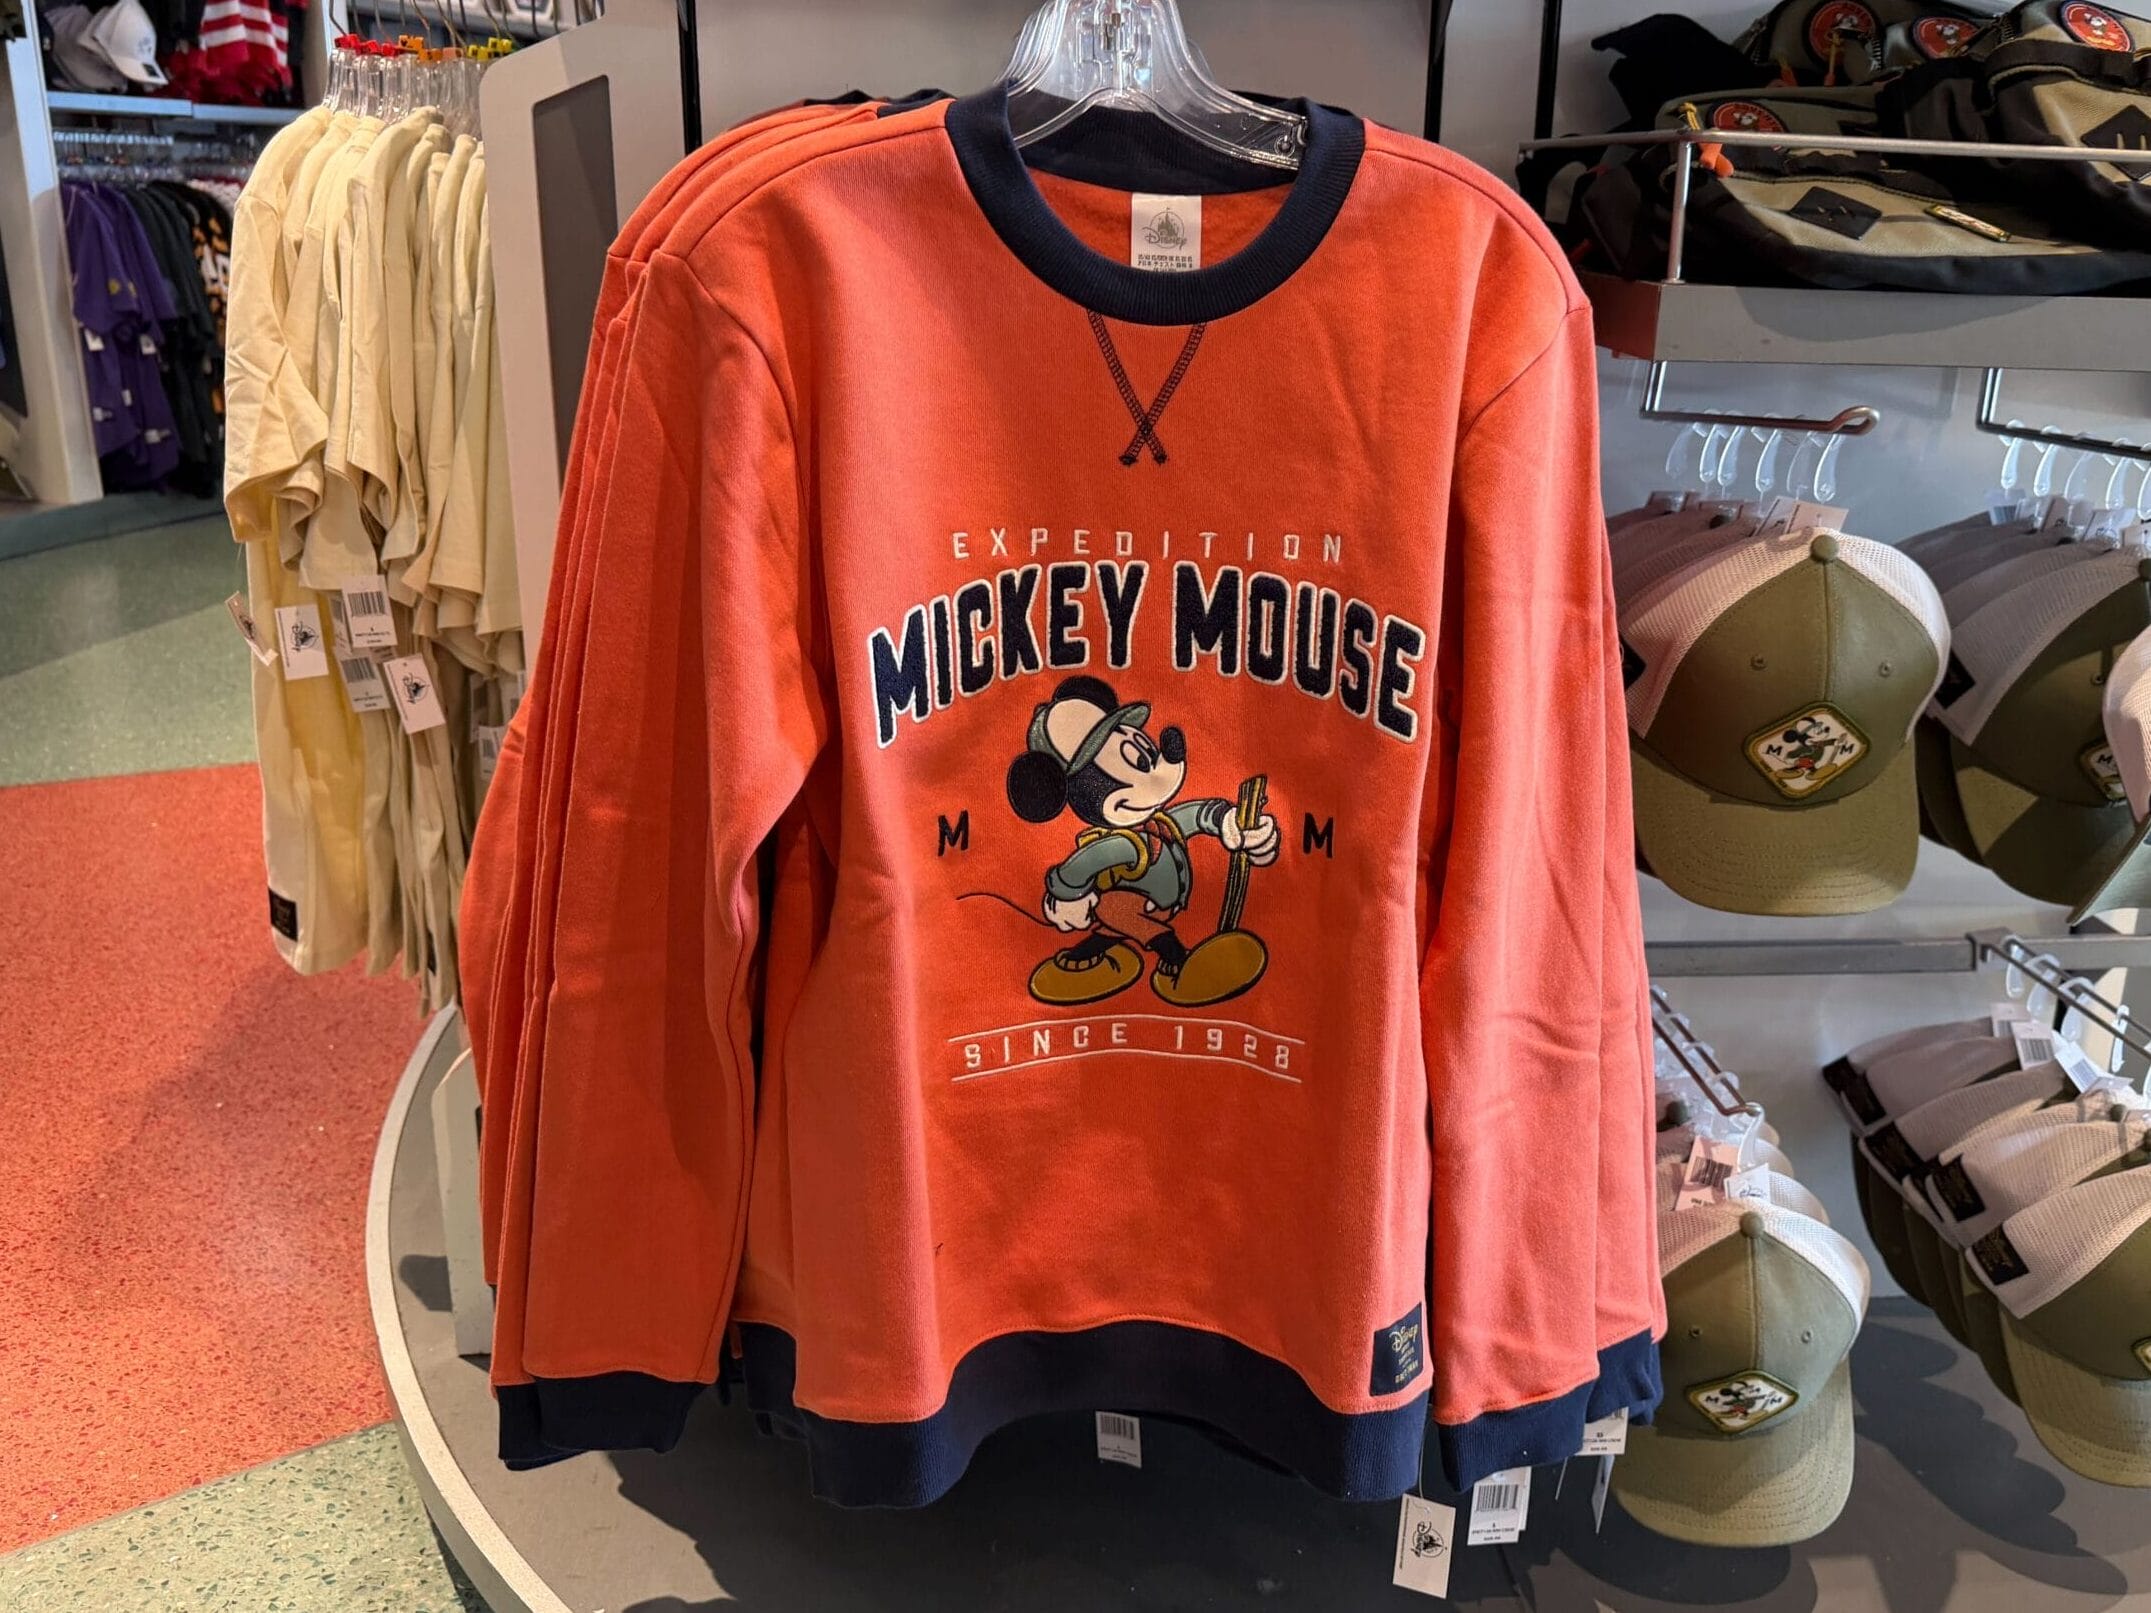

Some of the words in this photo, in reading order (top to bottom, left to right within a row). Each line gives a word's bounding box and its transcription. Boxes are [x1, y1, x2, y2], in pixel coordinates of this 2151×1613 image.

[952, 528, 1342, 565] EXPEDITION
[867, 560, 1149, 749] MICKEY
[1172, 560, 1426, 743] MOUSE
[1766, 744, 1783, 756] M
[937, 810, 970, 857] M
[1302, 812, 1334, 858] M
[964, 1023, 1128, 1069] SINCE
[1174, 1025, 1290, 1069] 1928
